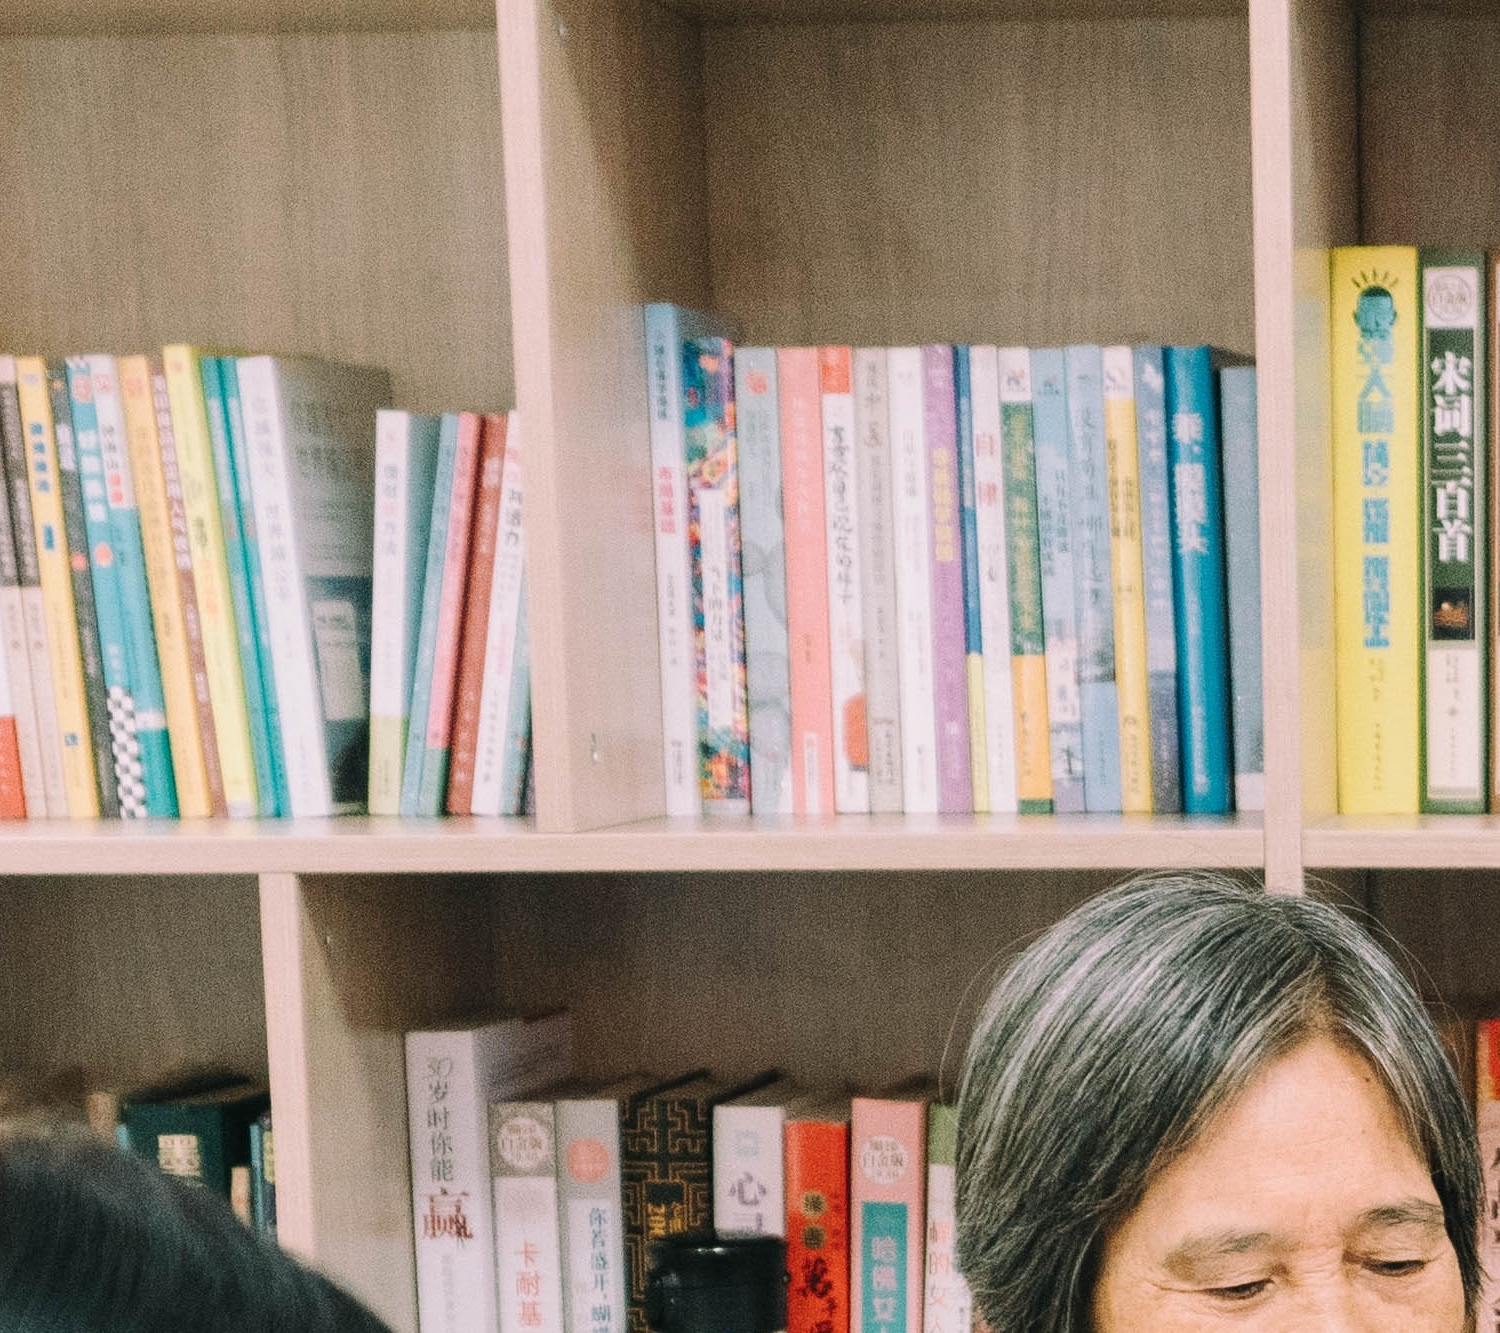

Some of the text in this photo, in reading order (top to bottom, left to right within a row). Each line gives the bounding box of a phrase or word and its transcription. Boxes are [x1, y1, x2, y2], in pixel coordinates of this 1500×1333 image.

[1431, 350, 1472, 563] 宋词三百首
